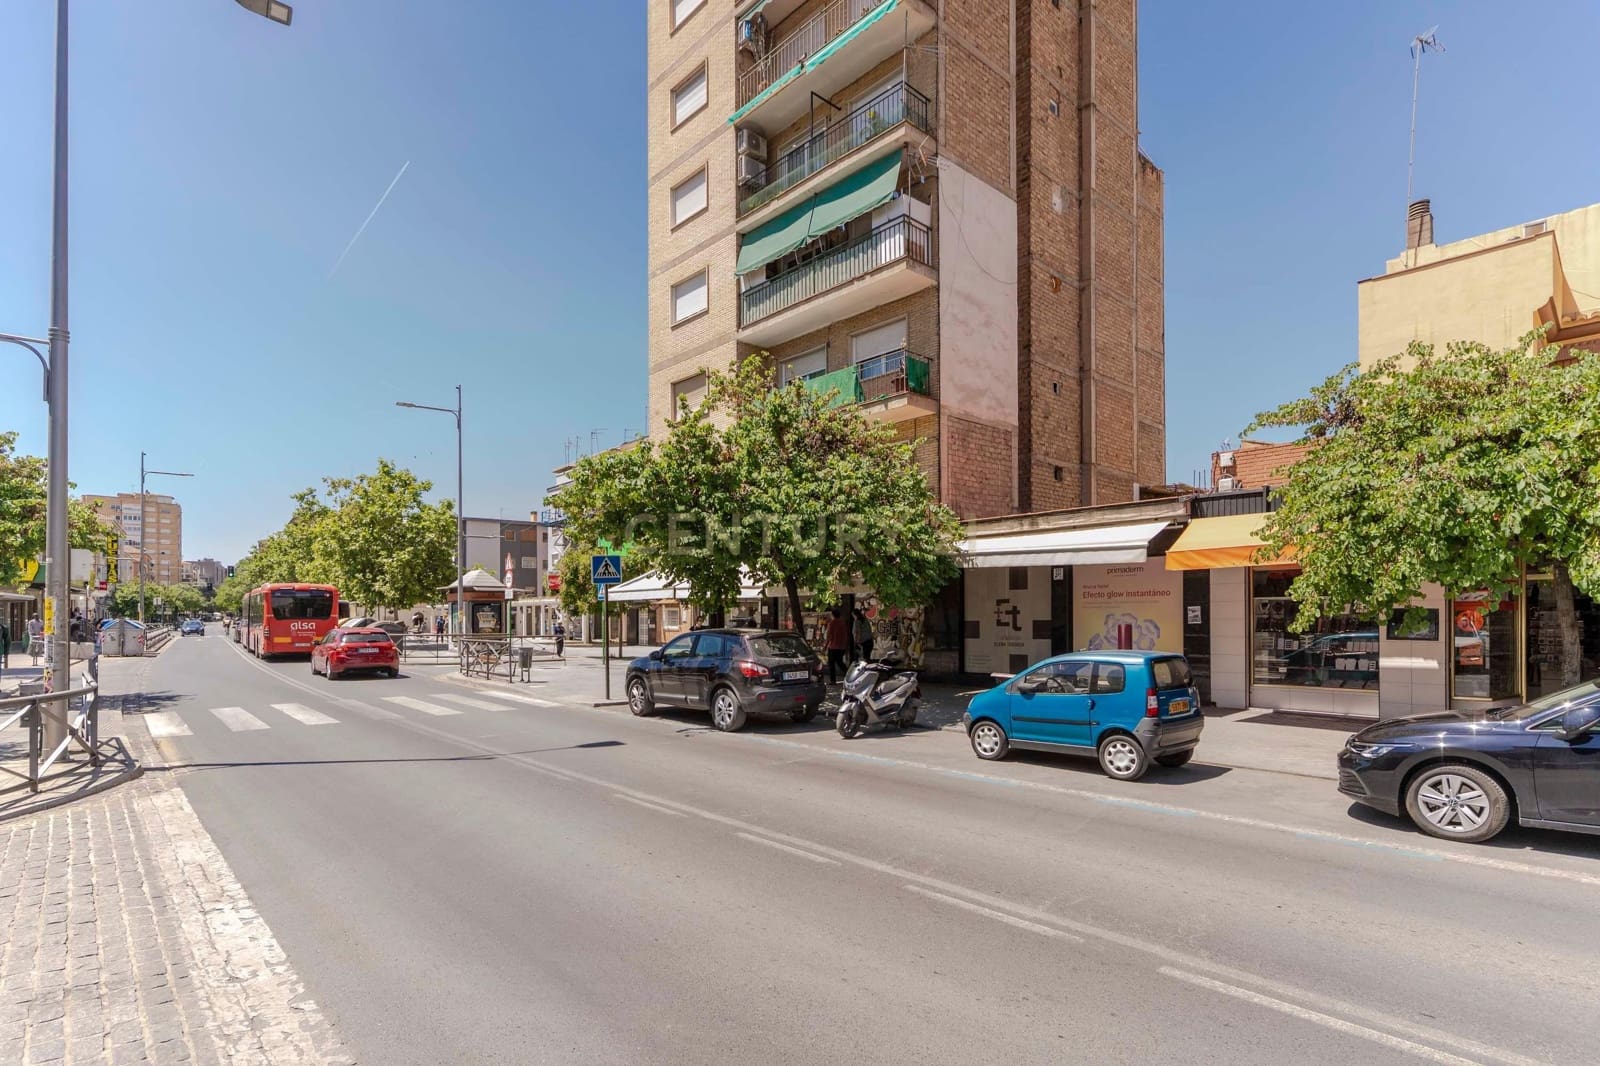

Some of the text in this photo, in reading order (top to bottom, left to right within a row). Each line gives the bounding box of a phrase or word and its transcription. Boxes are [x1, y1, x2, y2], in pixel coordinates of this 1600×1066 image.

[1082, 587, 1171, 600] Efecto glow instantáneo
[290, 621, 316, 630] alsa
